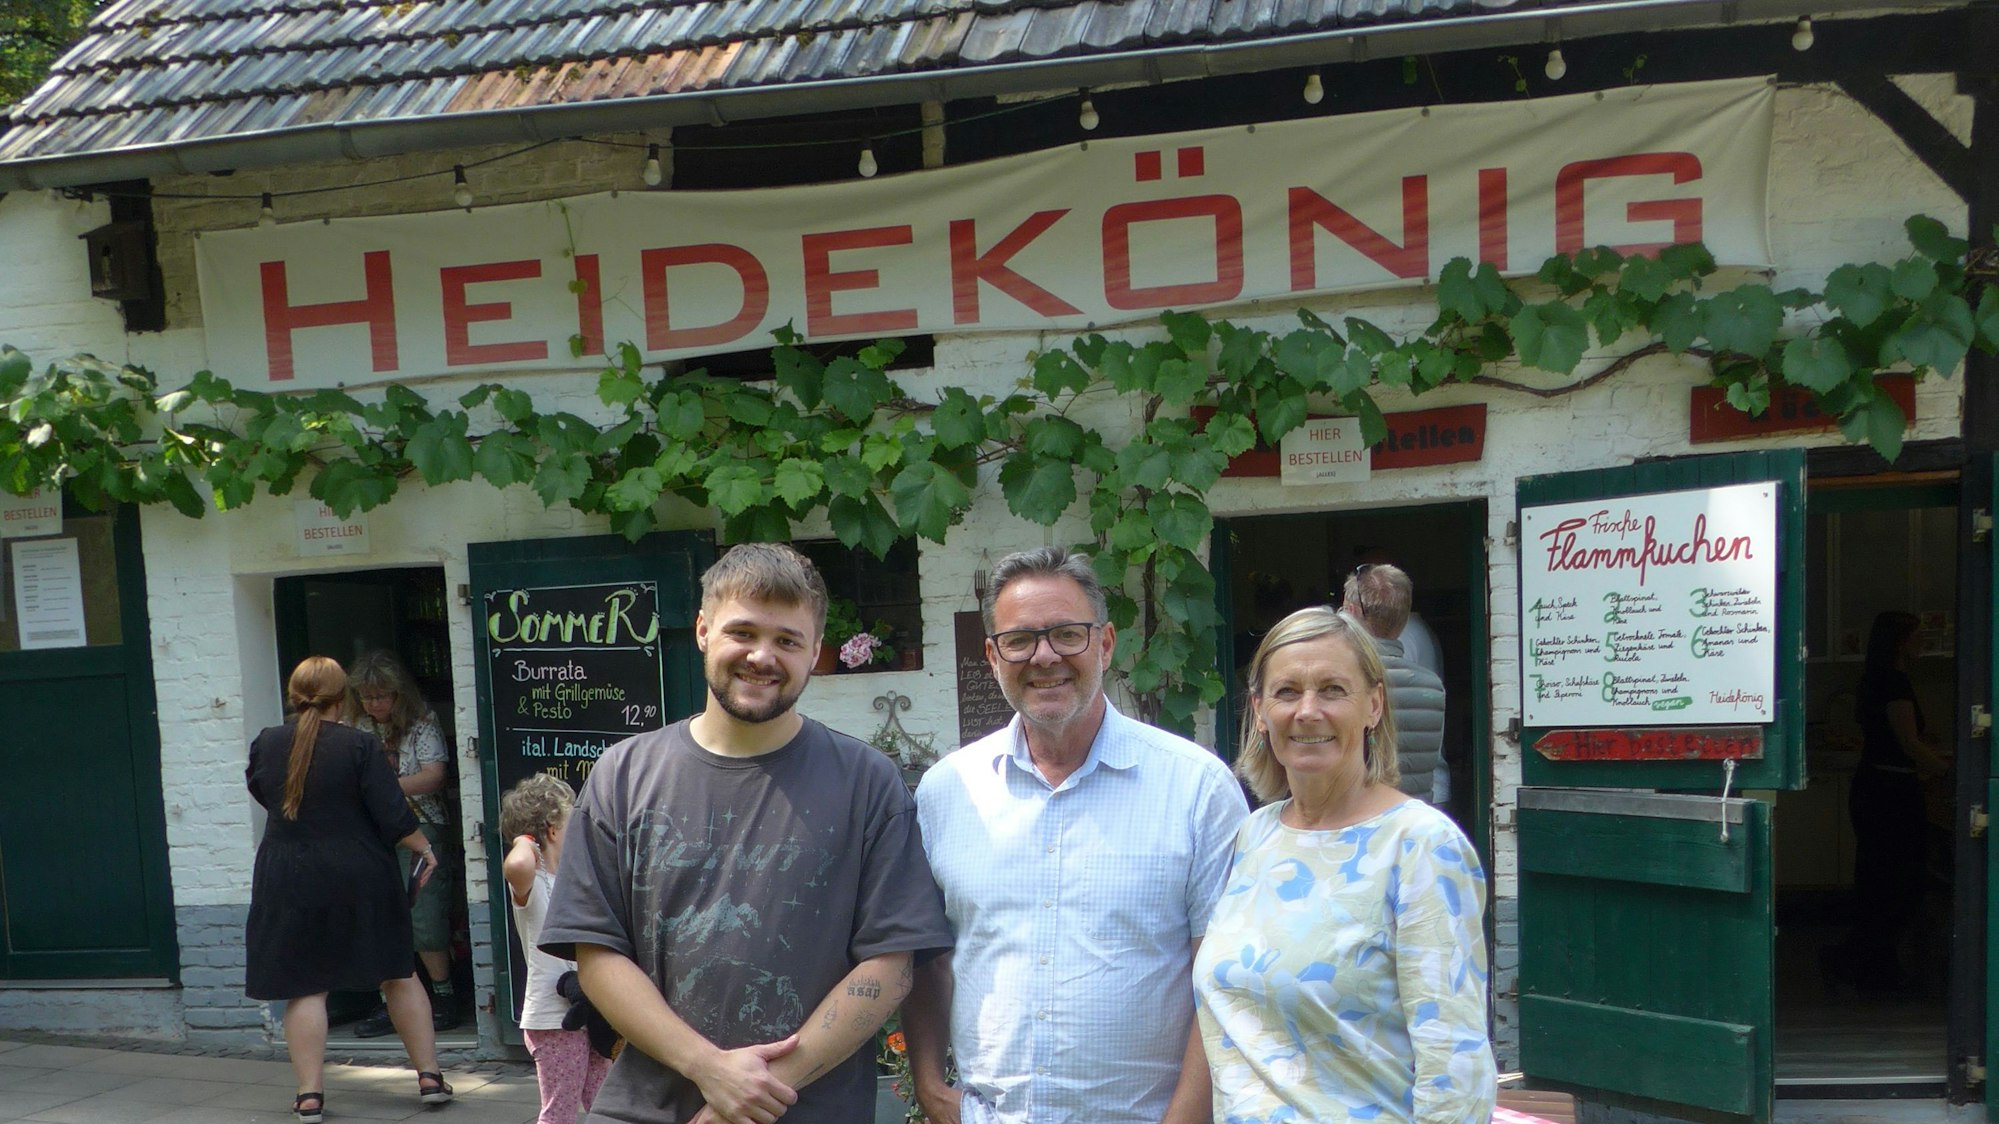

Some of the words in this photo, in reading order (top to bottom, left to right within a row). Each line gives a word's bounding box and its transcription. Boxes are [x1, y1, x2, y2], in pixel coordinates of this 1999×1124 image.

[259, 149, 1704, 381] HEIDEKÖNIG
[1309, 428, 1342, 441] HIER
[1289, 450, 1362, 466] BESTELLEN
[4, 507, 57, 521] BESTELLEN
[304, 525, 363, 540] BESTELLEN
[1589, 509, 1642, 540] Frische
[1540, 513, 1753, 586] Flammkuchen
[1649, 605, 1662, 613] und
[1658, 640, 1674, 649] und
[1738, 635, 1759, 644] und
[1585, 646, 1601, 654] und
[512, 660, 588, 682] Burrata
[532, 686, 551, 699] mit
[554, 683, 627, 709] Grillgemüse
[1661, 685, 1679, 694] und
[517, 696, 530, 715] &
[534, 702, 573, 719] Pesto
[1709, 689, 1764, 711] Heidekönig
[521, 735, 552, 757] ital.
[546, 760, 570, 779] mit
[847, 985, 880, 1001] asap
